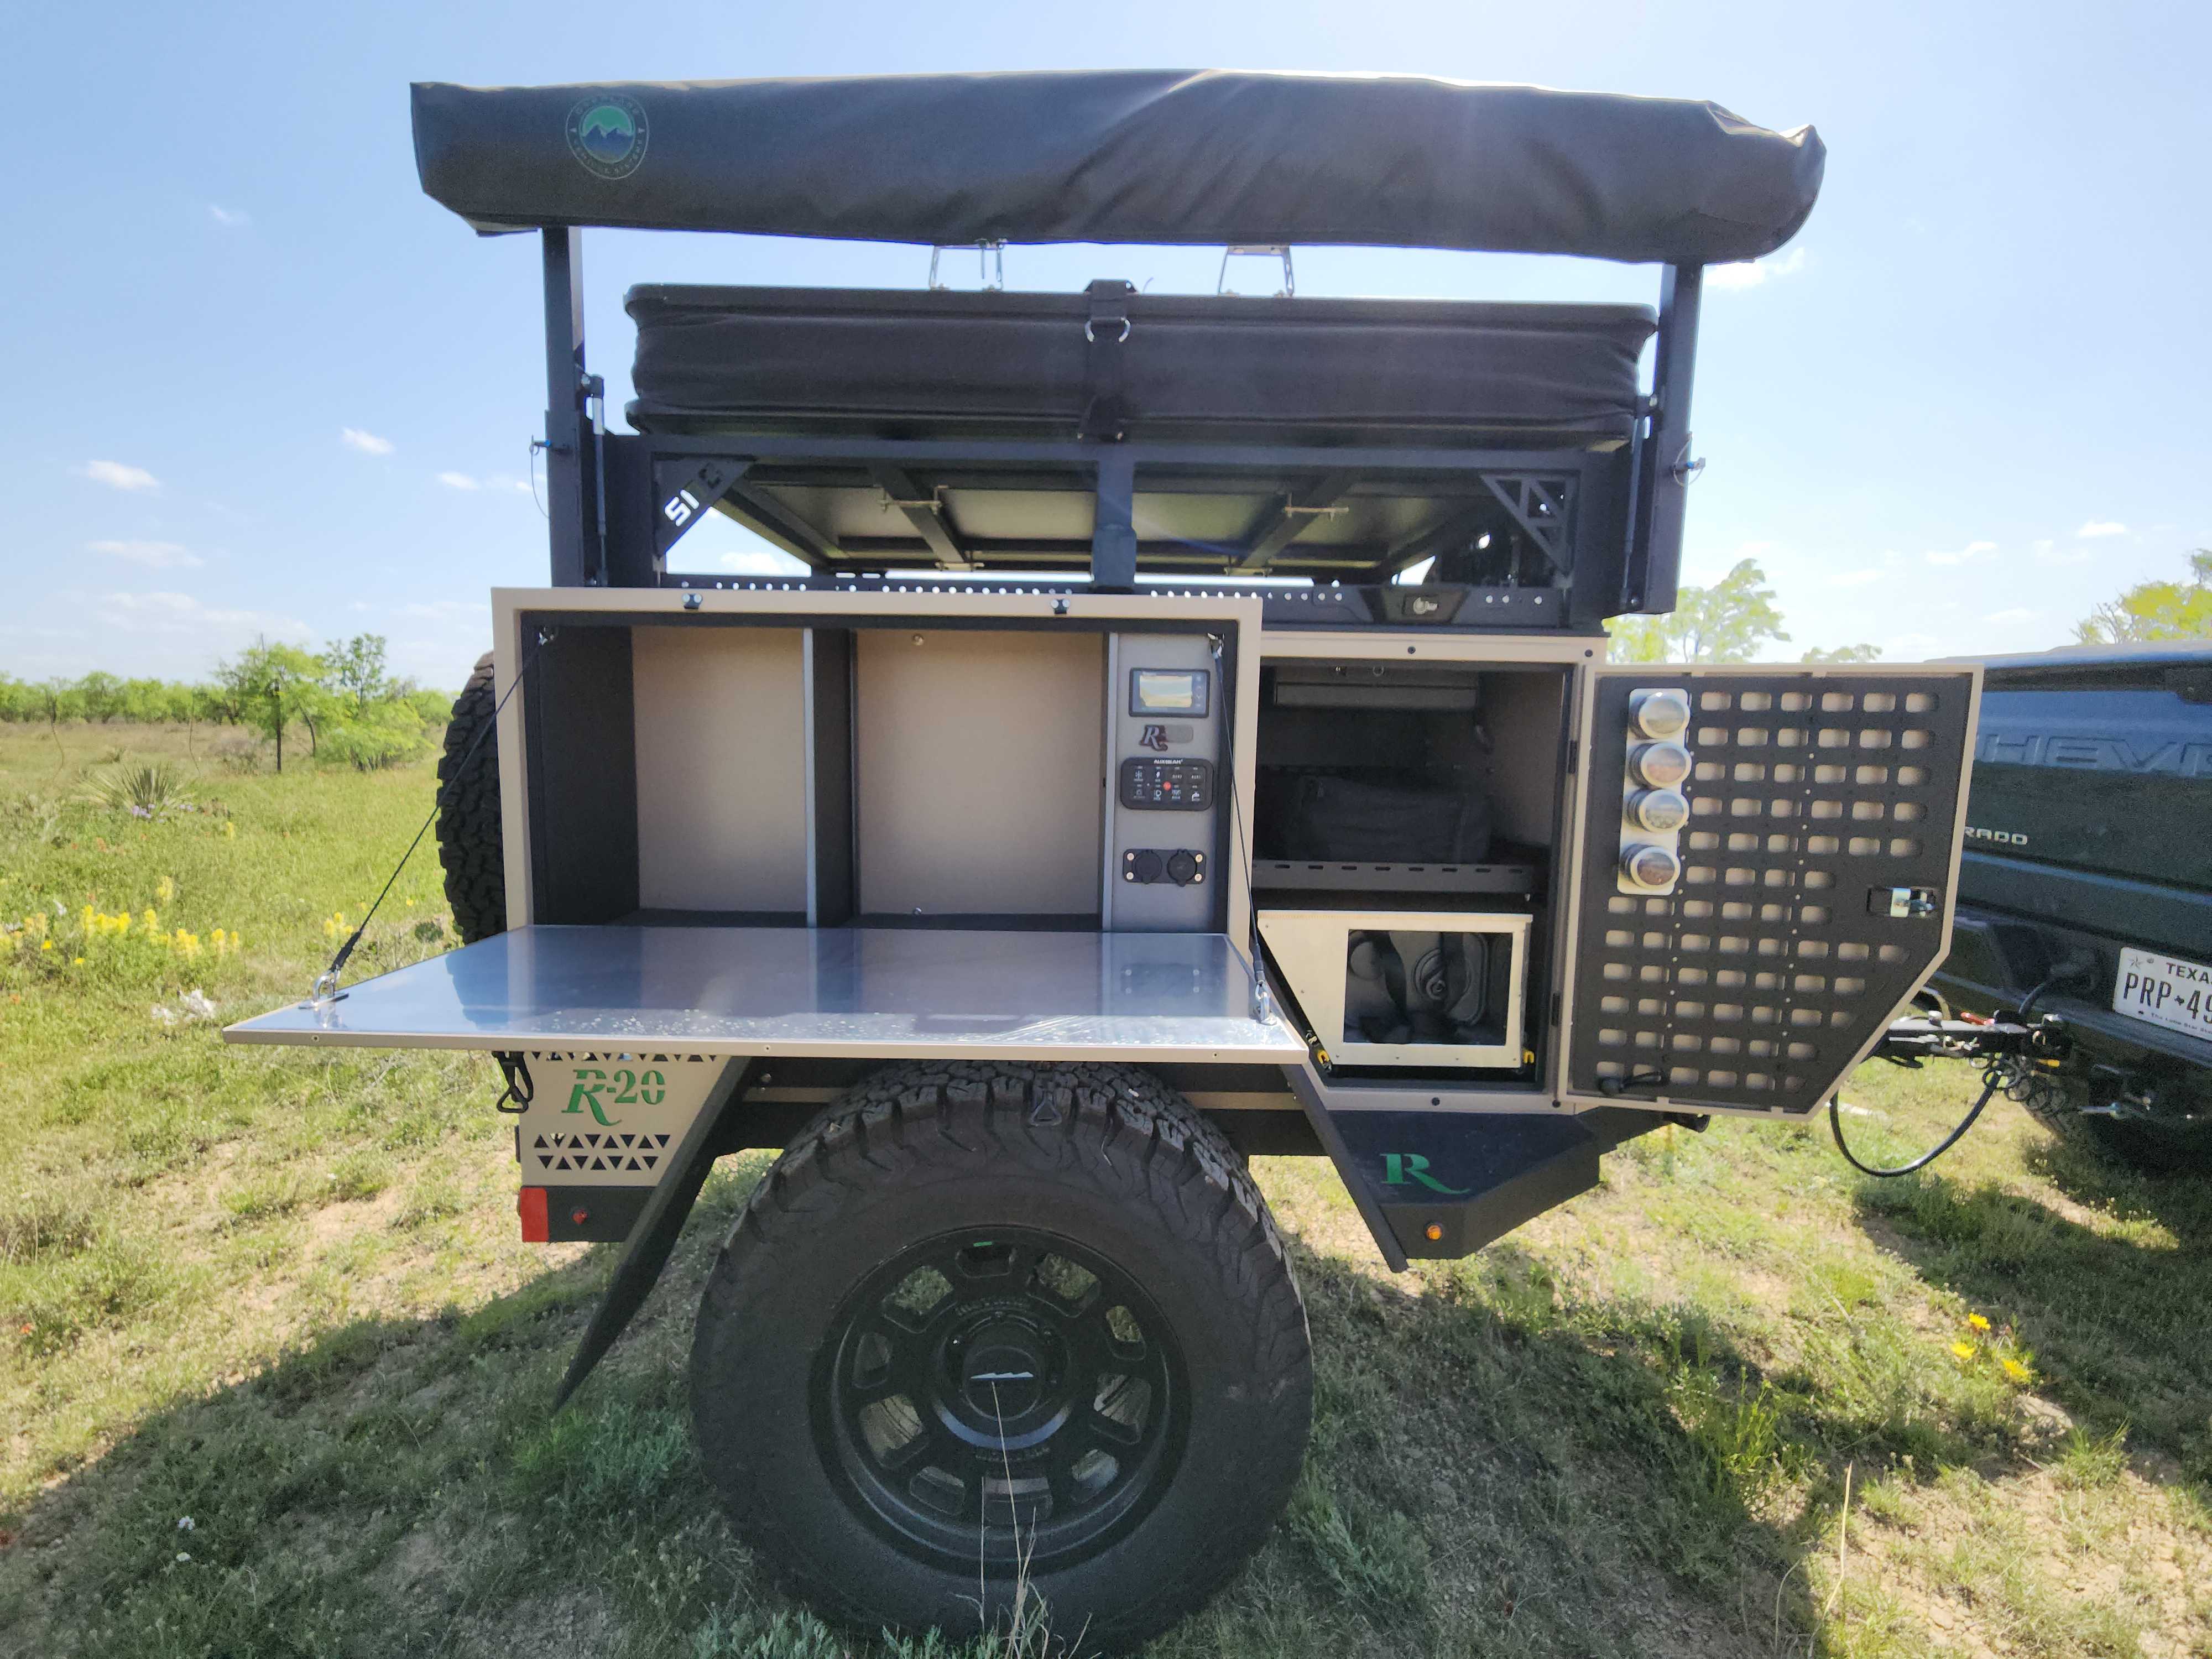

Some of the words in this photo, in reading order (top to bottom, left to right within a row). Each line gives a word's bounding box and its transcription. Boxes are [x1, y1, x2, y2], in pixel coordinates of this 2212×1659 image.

[1976, 734, 2212, 776] HEVR
[2166, 962, 2212, 985] TEXA
[561, 1068, 666, 1127] R-20
[1379, 1152, 1472, 1195] R
